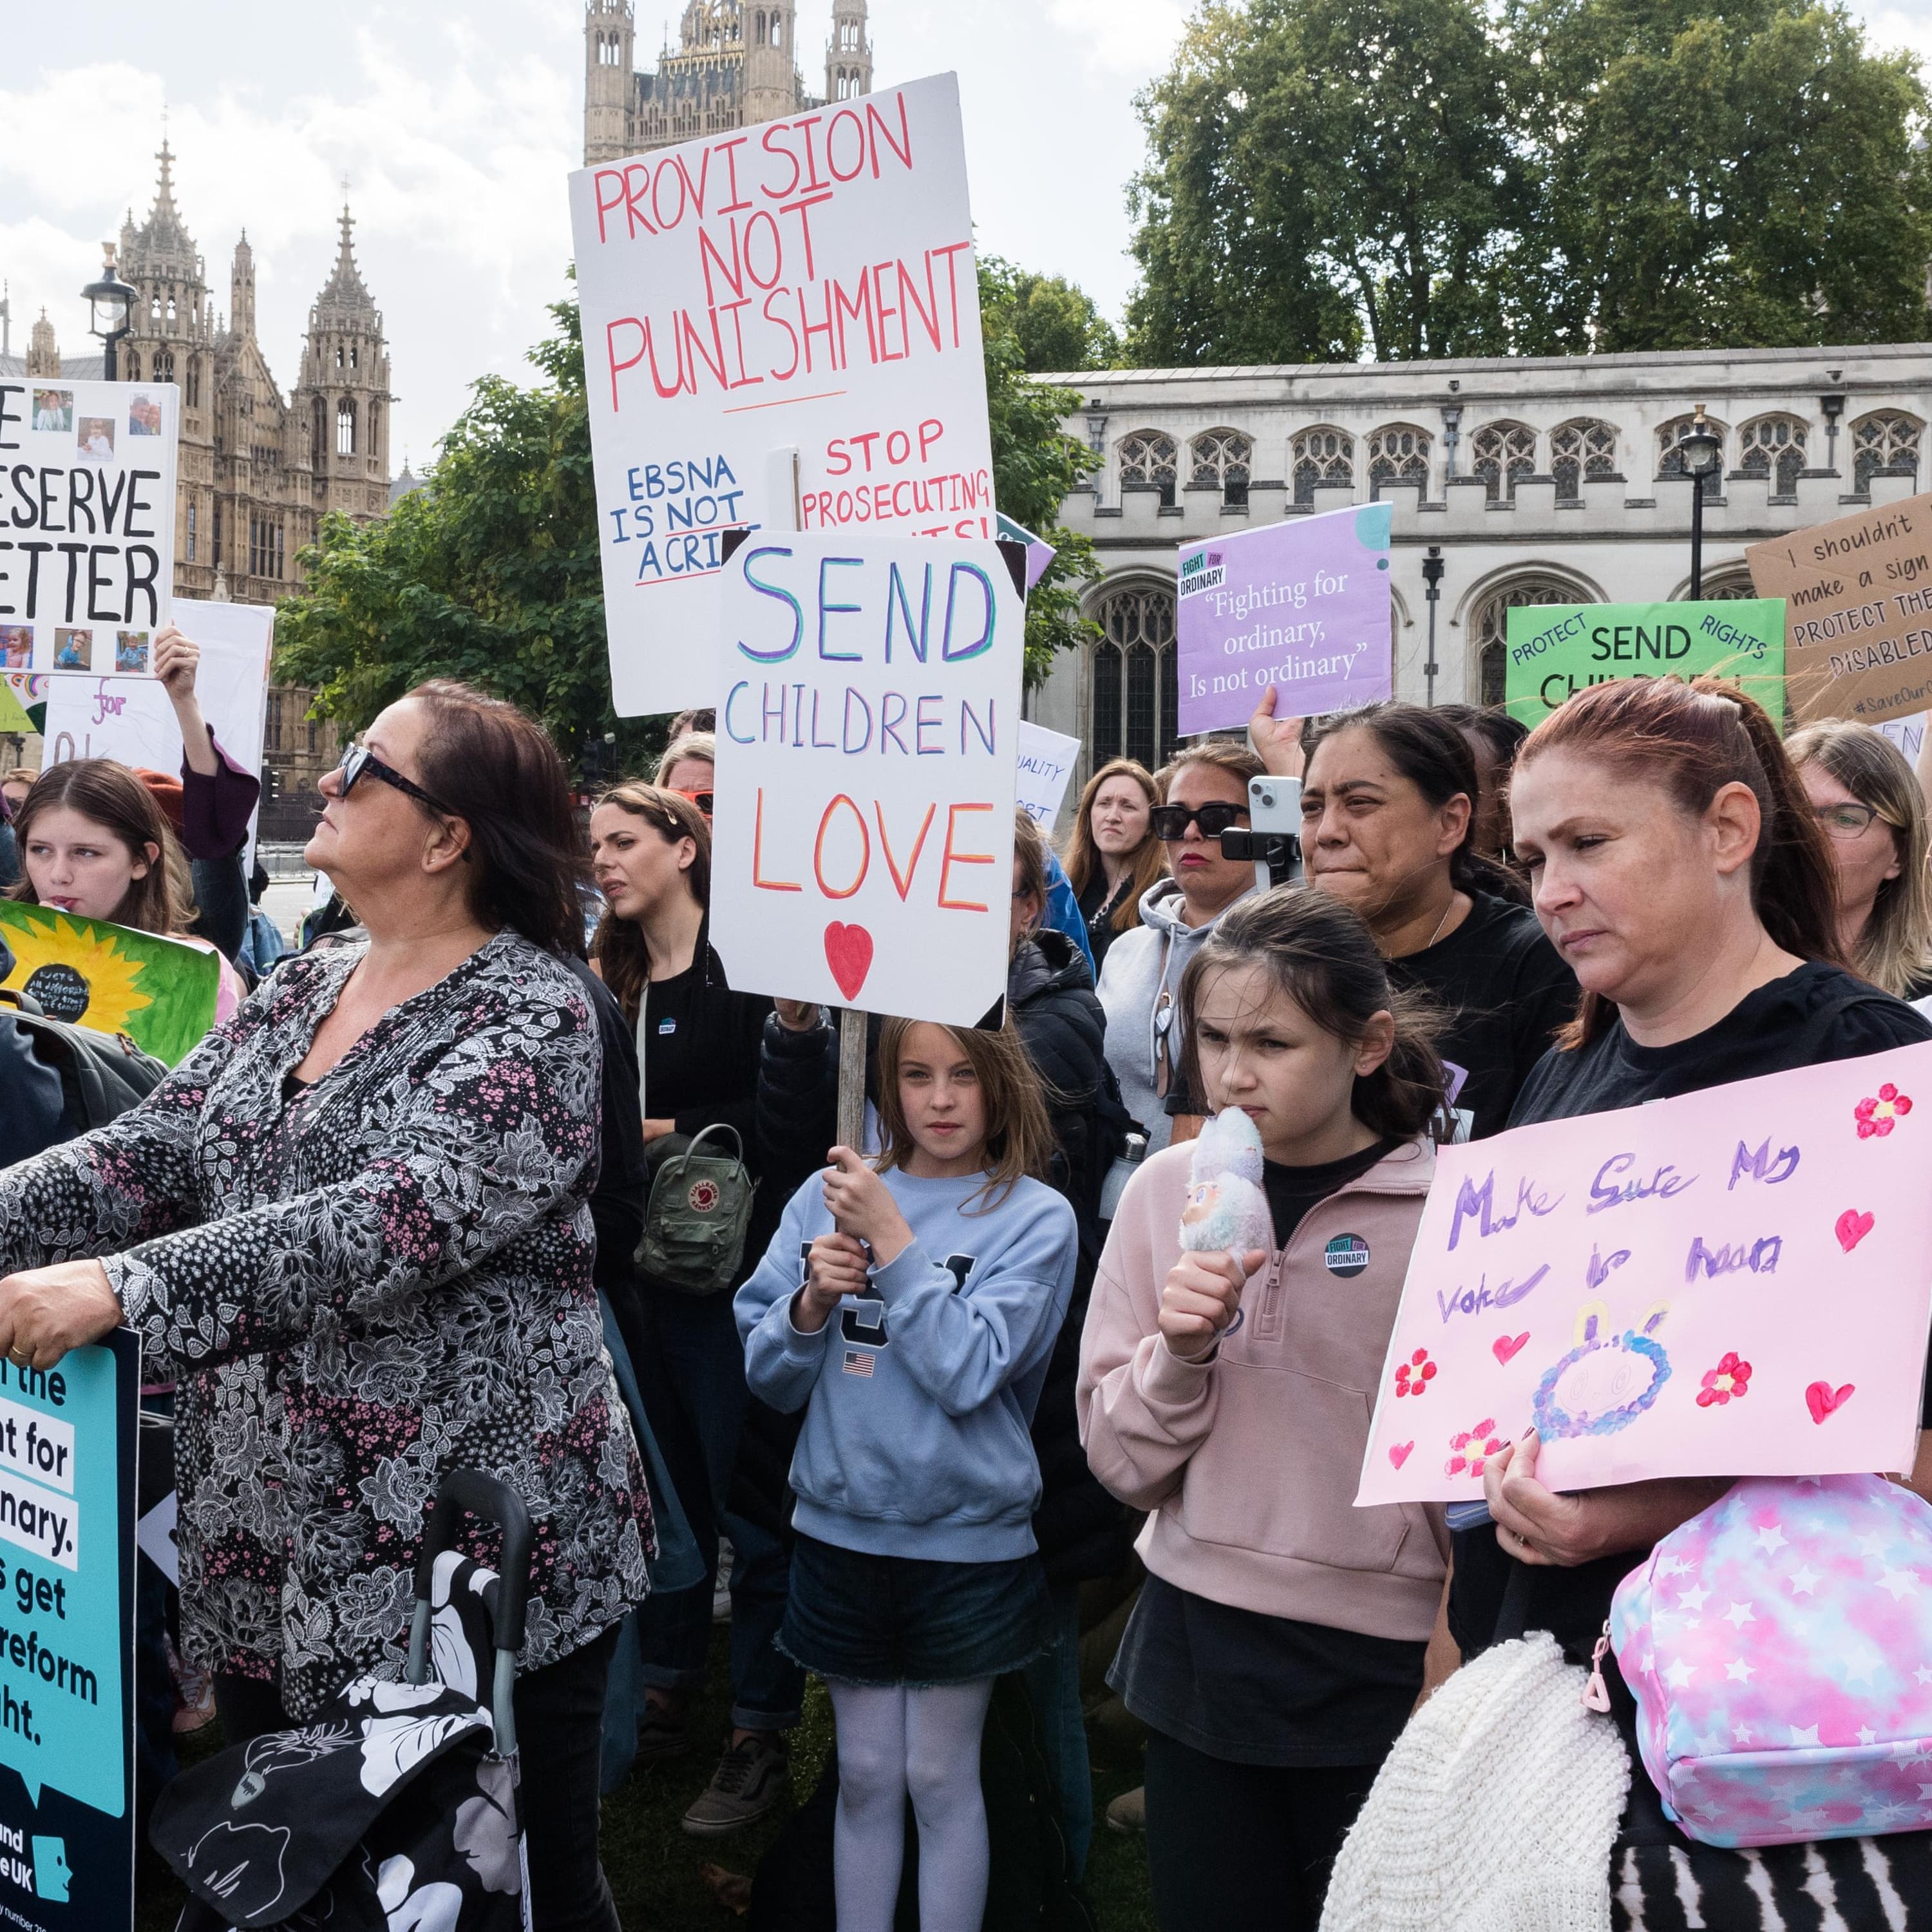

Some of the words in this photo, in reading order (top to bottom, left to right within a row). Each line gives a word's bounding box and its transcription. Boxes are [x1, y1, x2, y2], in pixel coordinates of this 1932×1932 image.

[594, 91, 913, 243] PROVISION
[699, 191, 833, 307] NOT
[607, 242, 970, 412] PUNISHMENT
[826, 419, 943, 475] STOP
[628, 455, 736, 501] EBSNA
[802, 469, 990, 529] PROSECUTING
[610, 505, 654, 544] IS
[667, 490, 744, 531] NOT
[1814, 515, 1913, 560] shouldn't
[639, 540, 663, 579] A
[1180, 568, 1223, 596] ORDINARY
[1182, 553, 1204, 576] FIGHT
[1209, 554, 1221, 565] FOR
[1314, 570, 1348, 597] for
[1792, 580, 1844, 607] make
[1859, 571, 1873, 587] a
[1886, 555, 1929, 581] sign
[737, 547, 997, 664] SEND
[1794, 601, 1886, 647] PROTECT
[1893, 587, 1932, 616] THE
[1224, 621, 1325, 656] ordinary,
[1512, 612, 1587, 666] PROTECT
[1591, 625, 1692, 661] SEND
[1700, 614, 1768, 660] RIGHTS
[91, 677, 126, 725] for
[1189, 674, 1206, 699] Is
[1213, 667, 1248, 694] not
[725, 681, 996, 755] CHILDREN
[753, 788, 996, 912] LOVE
[1327, 1252, 1366, 1265] ORDINARY
[1329, 1240, 1350, 1253] FIGHT
[1354, 1241, 1365, 1249] FOR
[19, 1365, 66, 1406] the
[26, 1421, 68, 1477] for
[1, 1490, 73, 1557] nary.
[15, 1567, 66, 1620] get
[0, 1626, 97, 1707] reform
[0, 1823, 23, 1853] nd
[12, 1858, 33, 1892] UK
